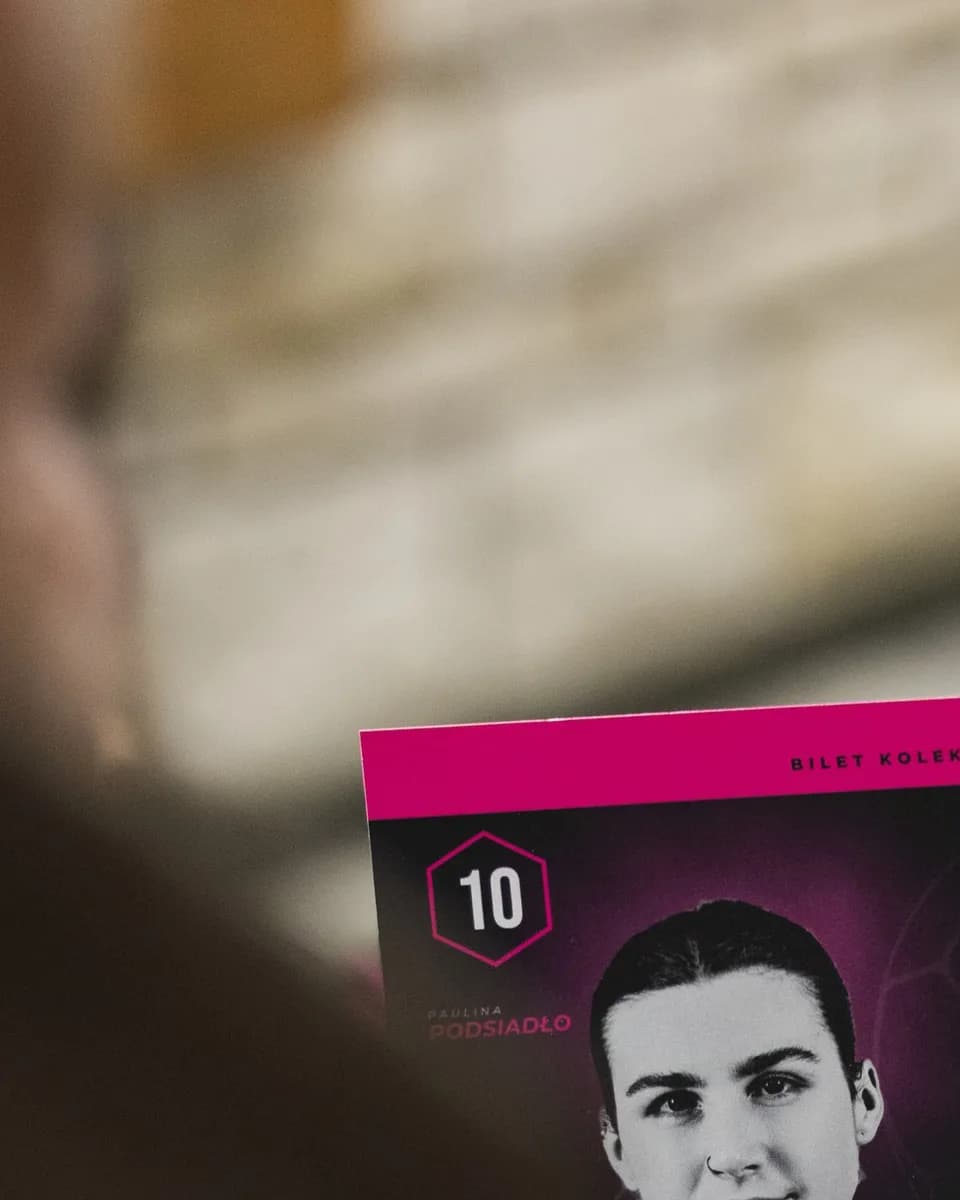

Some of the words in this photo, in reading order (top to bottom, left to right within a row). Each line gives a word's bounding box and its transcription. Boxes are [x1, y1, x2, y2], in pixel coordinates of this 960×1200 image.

[791, 754, 863, 771] BILET
[459, 866, 523, 931] 10
[428, 1006, 502, 1020] PAULINA
[429, 1014, 572, 1041] PODSIADŁO
